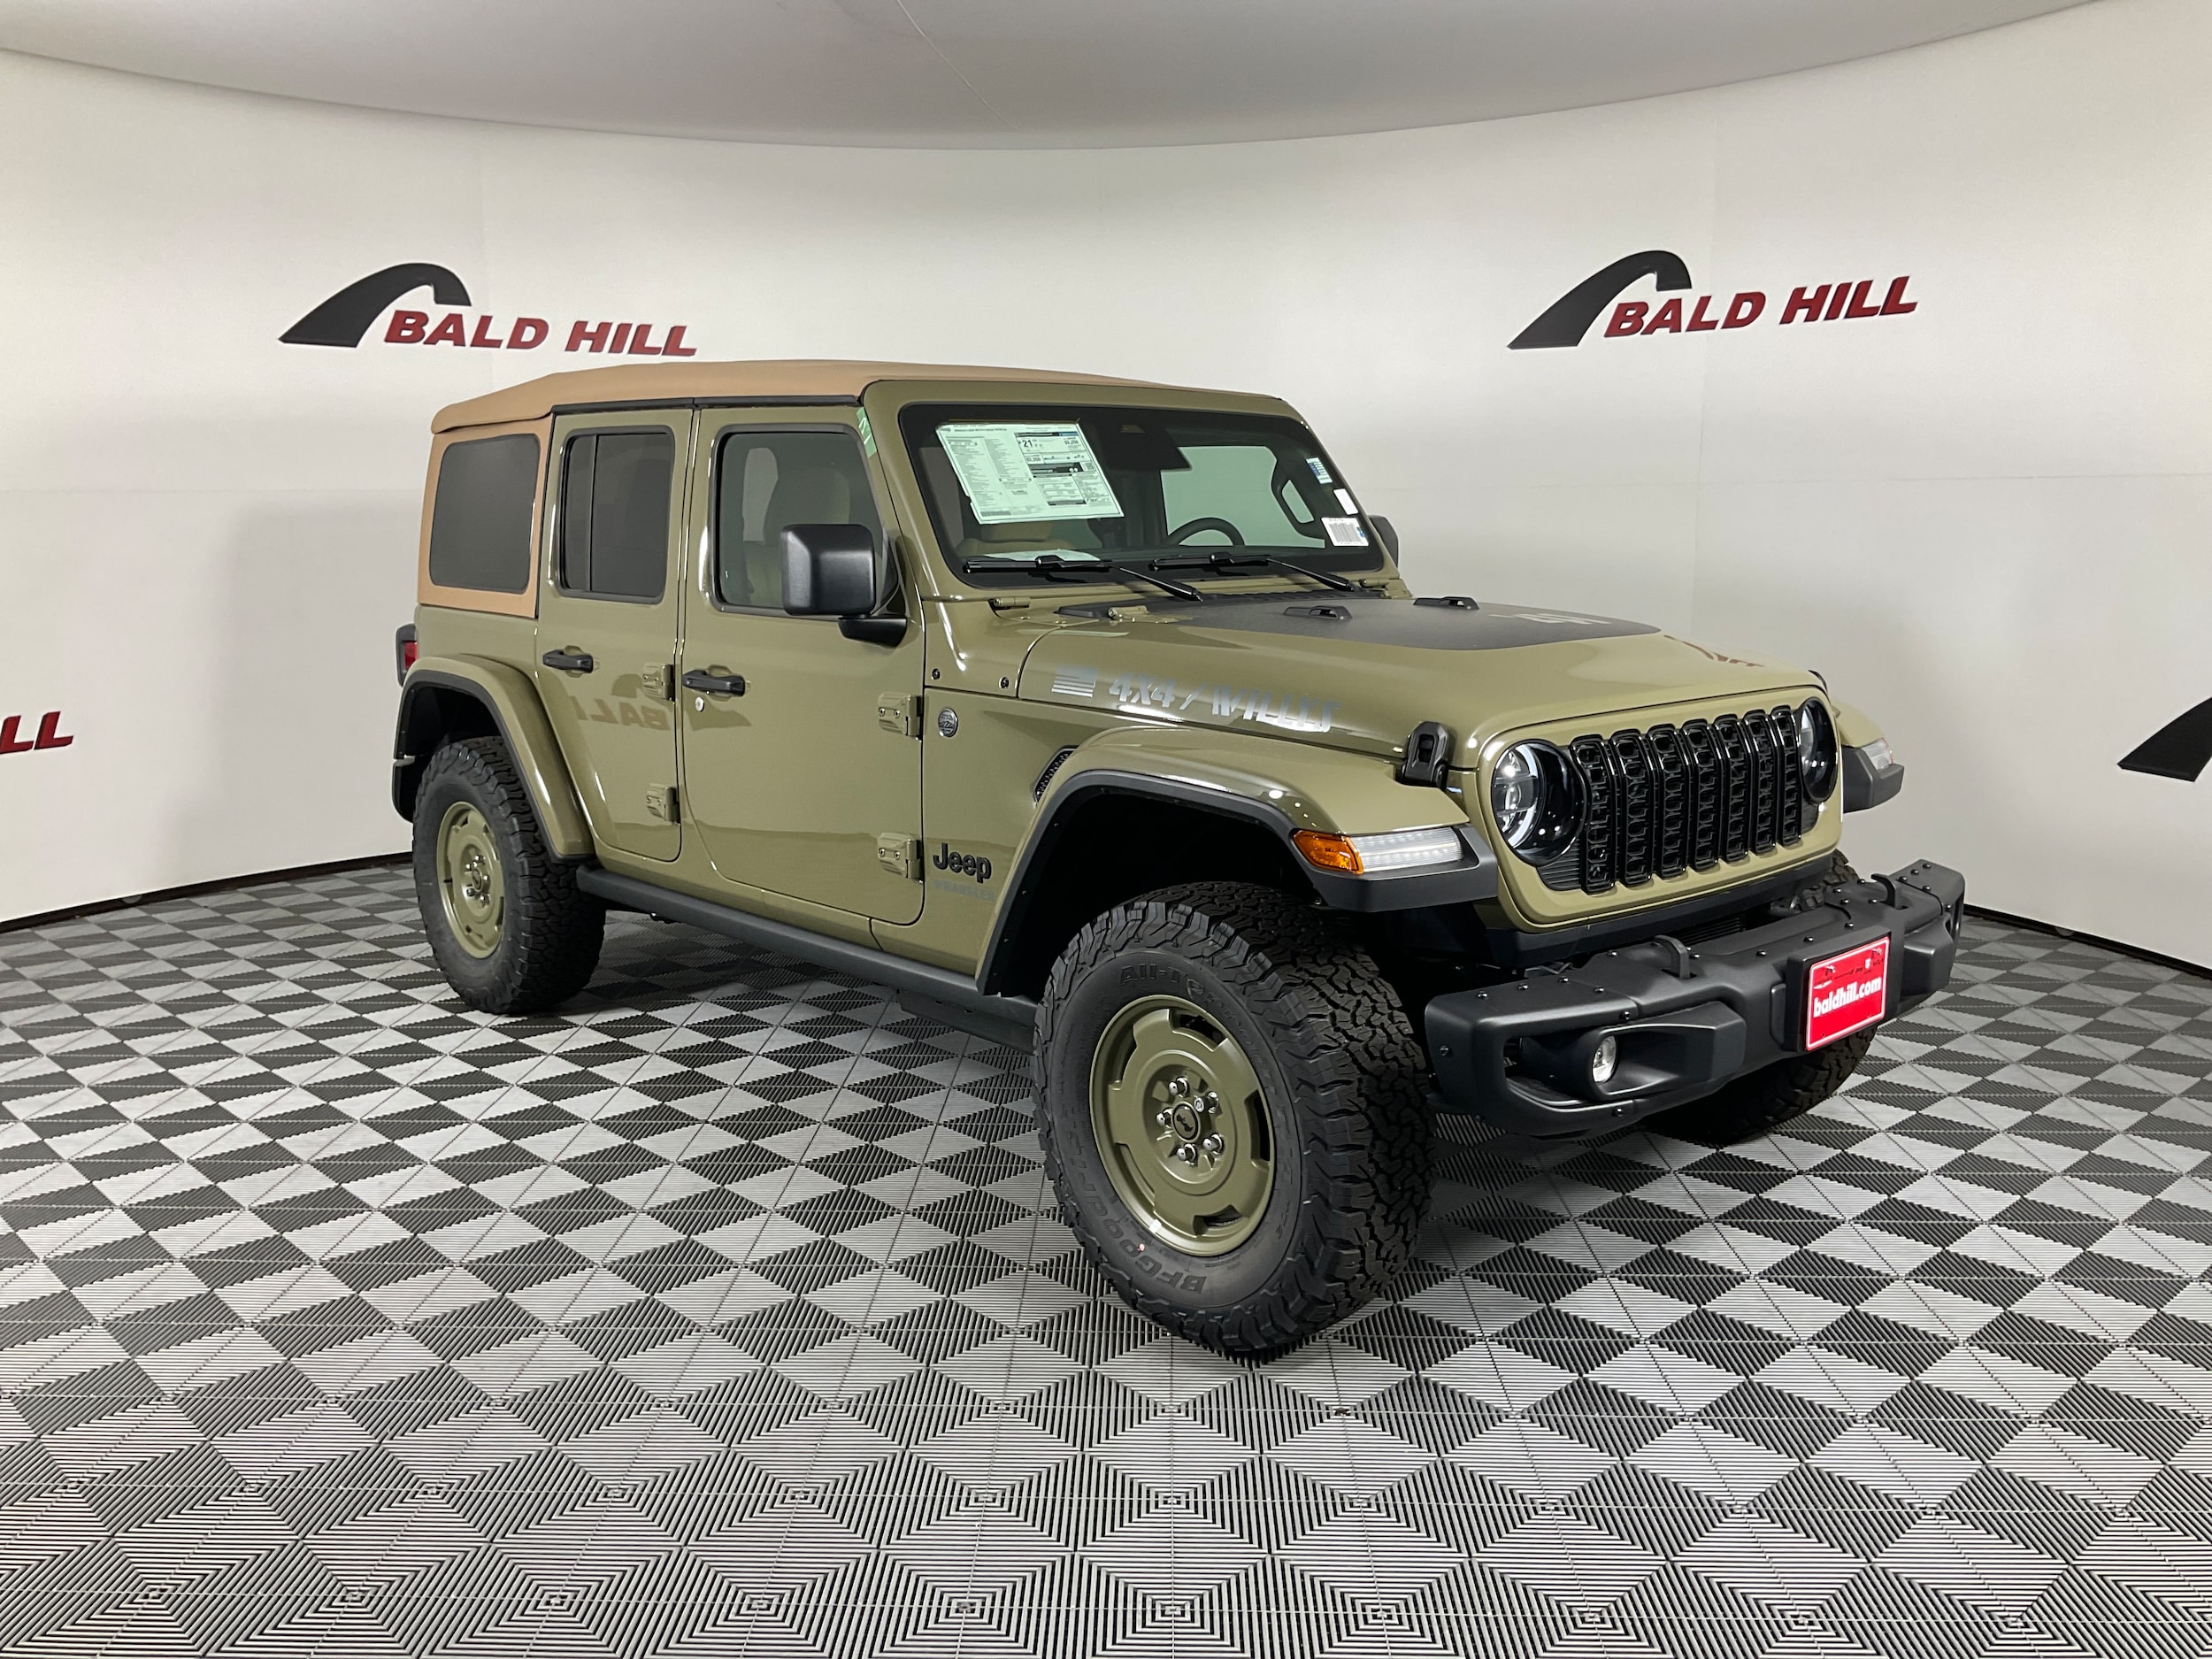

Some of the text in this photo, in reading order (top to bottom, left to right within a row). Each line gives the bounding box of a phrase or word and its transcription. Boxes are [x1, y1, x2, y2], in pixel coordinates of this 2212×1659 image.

[1603, 276, 1918, 338] BALD HILL
[384, 310, 697, 357] BALD HILL
[933, 842, 992, 884] Jeep
[1813, 977, 1882, 1018] baldhill.com
